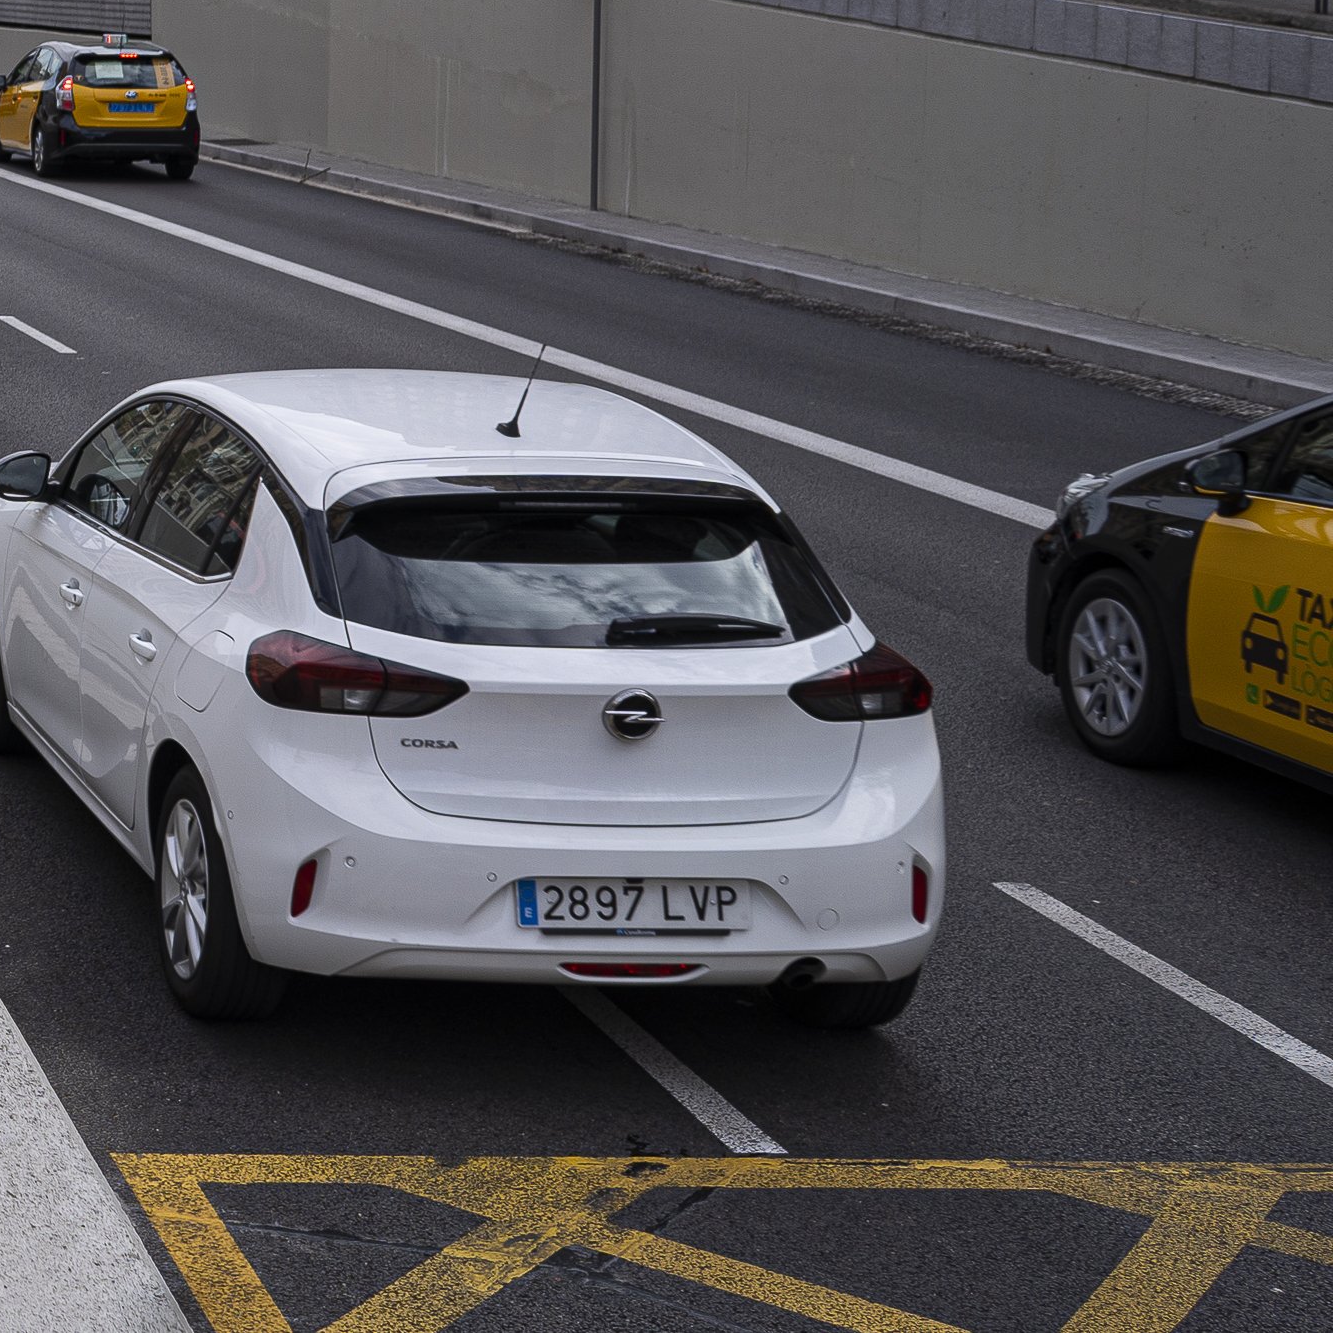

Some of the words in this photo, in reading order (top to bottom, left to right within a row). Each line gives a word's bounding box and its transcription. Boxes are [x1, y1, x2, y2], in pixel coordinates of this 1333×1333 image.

[1291, 622, 1333, 668] EC
[399, 737, 459, 750] CORSA
[542, 884, 645, 922] 2897
[660, 884, 738, 922] LVP
